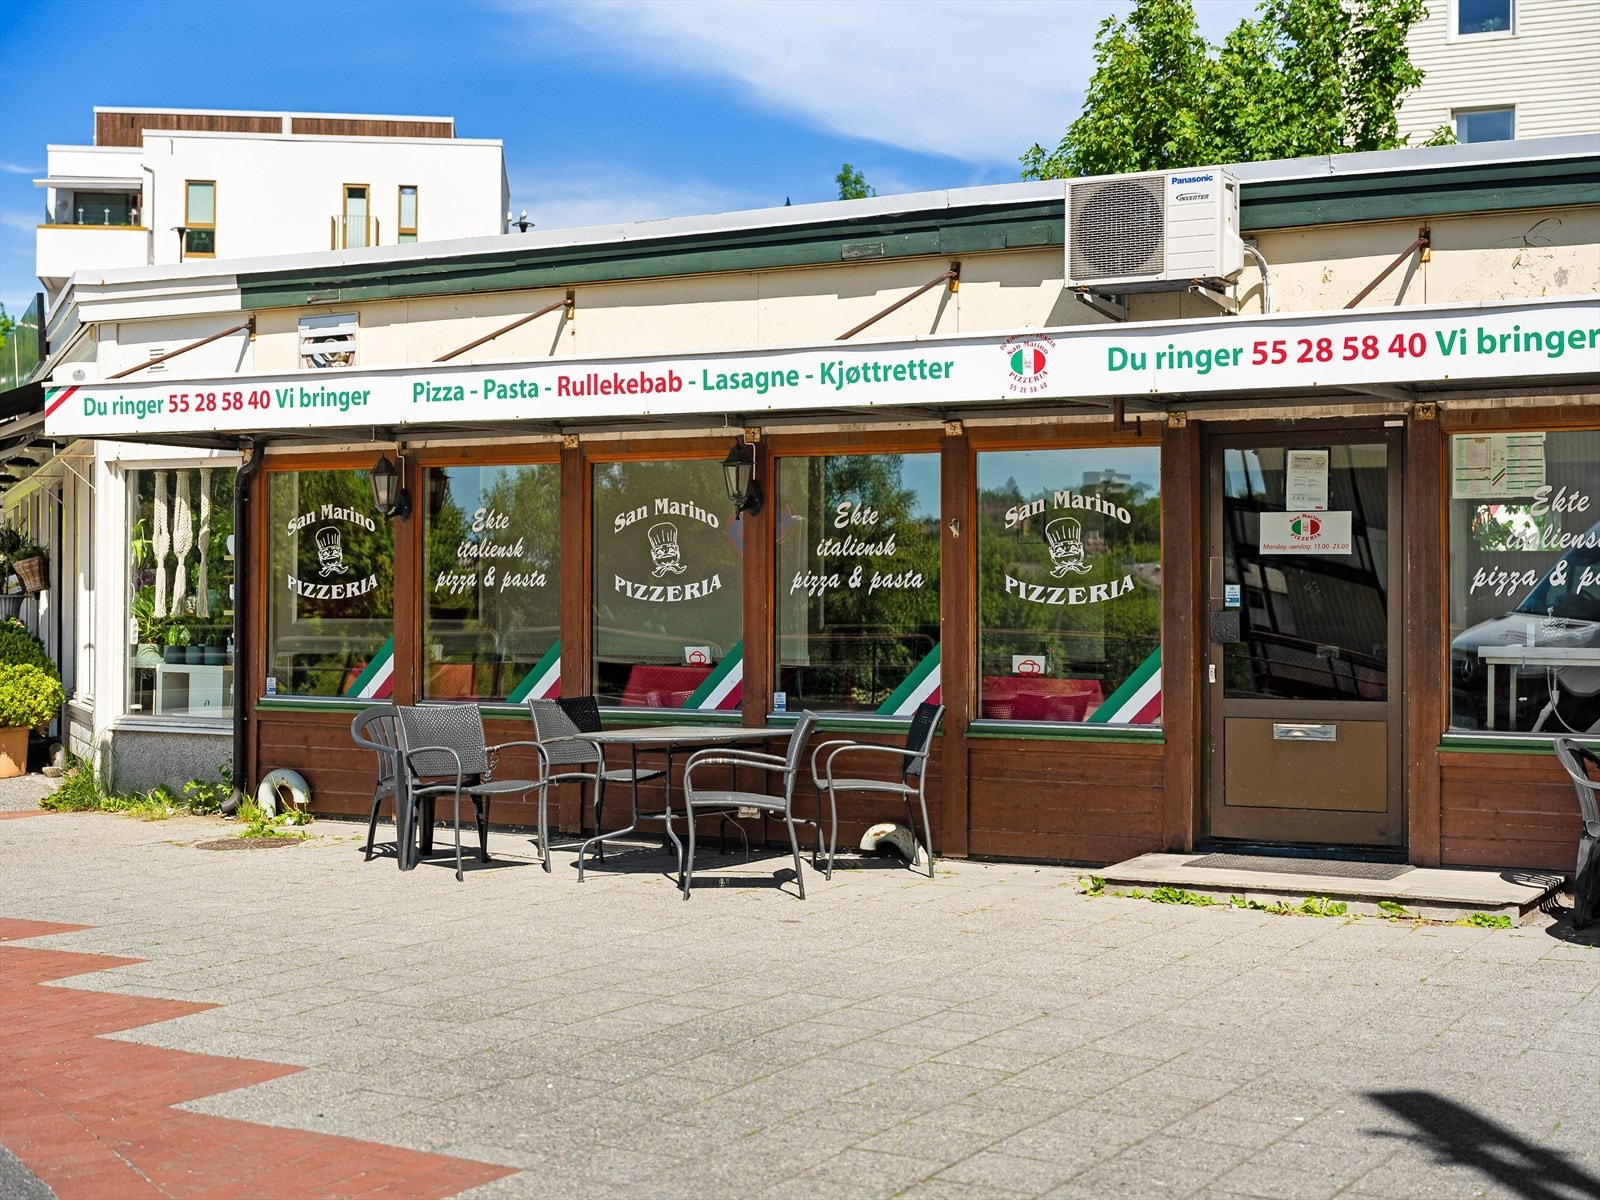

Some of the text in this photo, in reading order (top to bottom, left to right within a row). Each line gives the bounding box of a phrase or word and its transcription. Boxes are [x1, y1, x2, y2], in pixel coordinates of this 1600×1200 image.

[1171, 174, 1214, 184] Panasonic
[1007, 341, 1049, 356] San Marino
[1108, 325, 1600, 374] Du ringer 55 28 58 40 Vi bringer
[413, 381, 464, 402] Pizza
[483, 378, 539, 399] Pasta
[557, 369, 682, 396] Rullekebab
[702, 369, 800, 395] Lasagne
[820, 359, 954, 390] Kjøttretter
[1009, 370, 1048, 383] PIZZERIA
[84, 386, 370, 420] Du ringer 55 28 58 40 Vi bringer
[833, 501, 879, 529] Ekte
[1004, 490, 1132, 530] San Marino
[1529, 485, 1591, 516] Ekte
[287, 504, 376, 537] San Marino
[471, 507, 510, 532] Ekte
[614, 498, 719, 534] San Marino
[1289, 513, 1322, 524] San Marino
[457, 536, 524, 558] italiensk
[816, 533, 897, 557] italiensk
[1289, 532, 1322, 541] PIZZERIA
[1505, 523, 1600, 549] italiens
[287, 574, 378, 600] PIZZERIA
[434, 566, 548, 595] pizza & pasta
[614, 573, 722, 602] PIZZERIA
[789, 565, 924, 597] pizza & pasta
[1004, 573, 1135, 605] PIZZERIA
[1469, 565, 1539, 597] pizza
[1549, 559, 1569, 587] &
